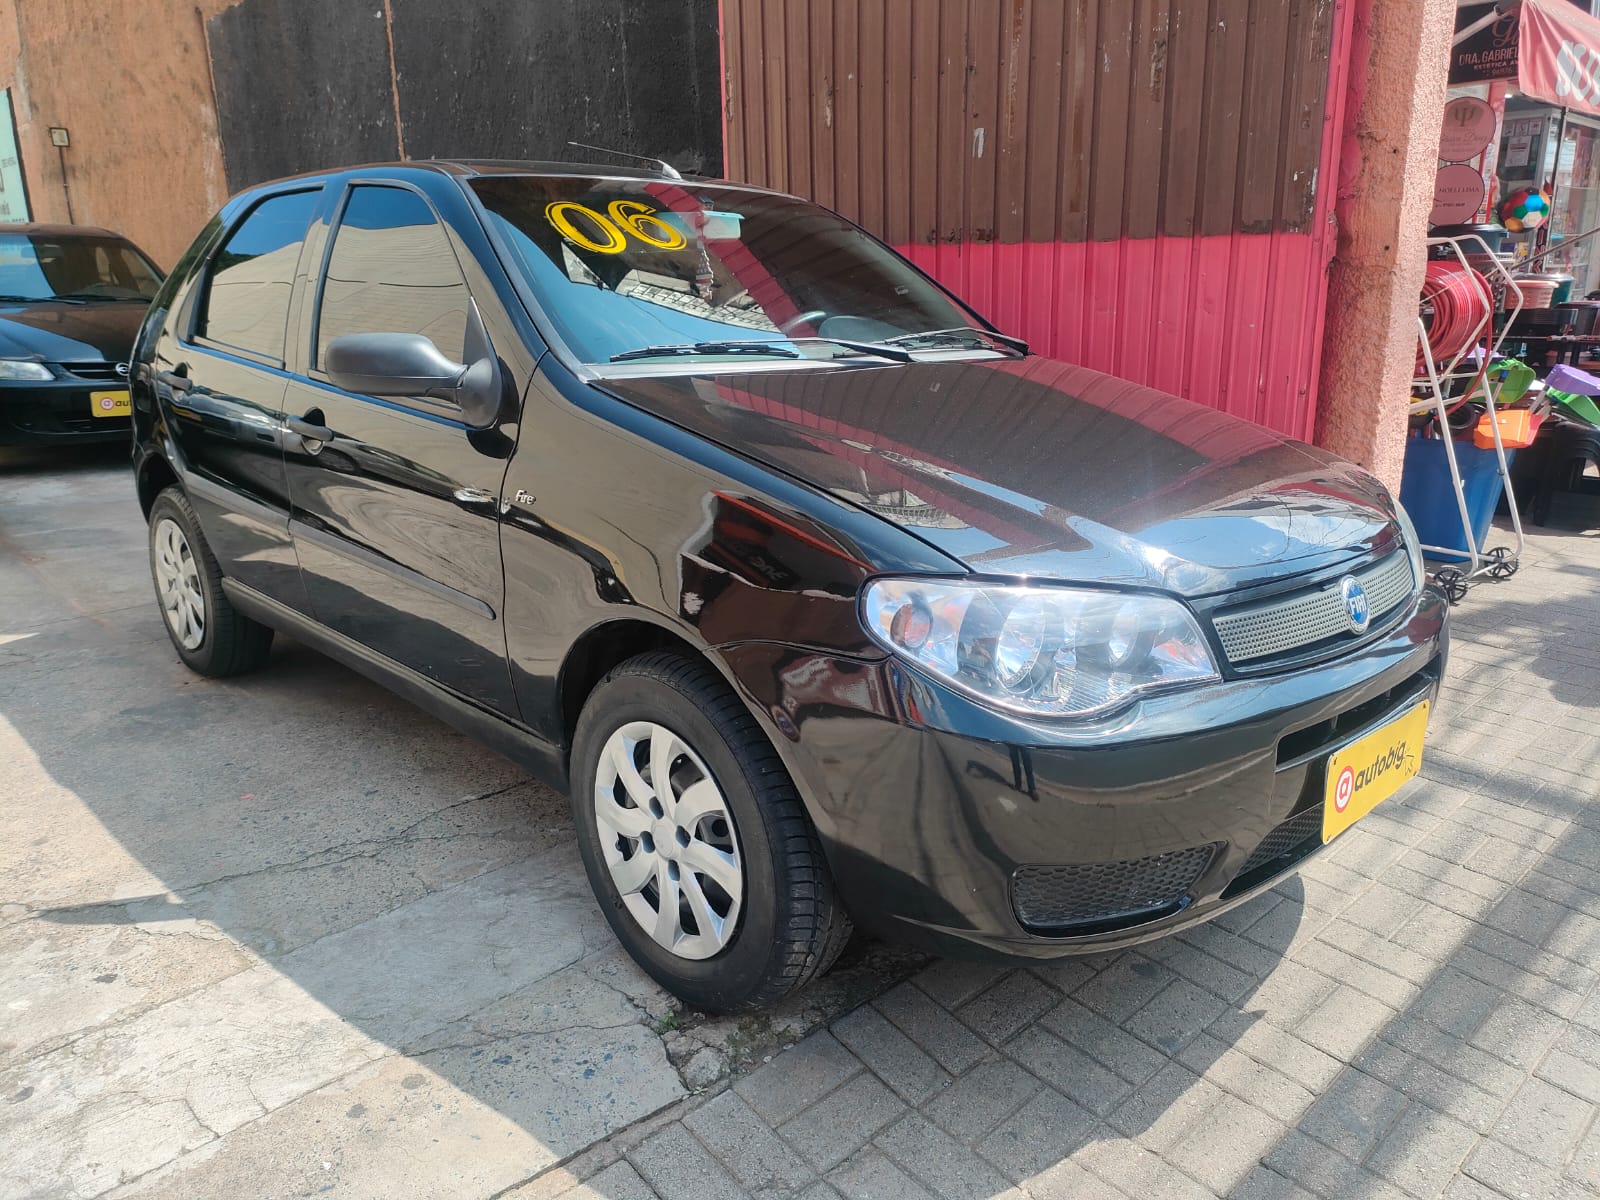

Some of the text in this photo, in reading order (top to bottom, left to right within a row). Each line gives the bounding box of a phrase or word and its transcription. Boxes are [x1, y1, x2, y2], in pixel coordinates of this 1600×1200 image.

[544, 200, 688, 255] 06
[515, 489, 536, 505] Fire
[1354, 740, 1406, 792] autobig
